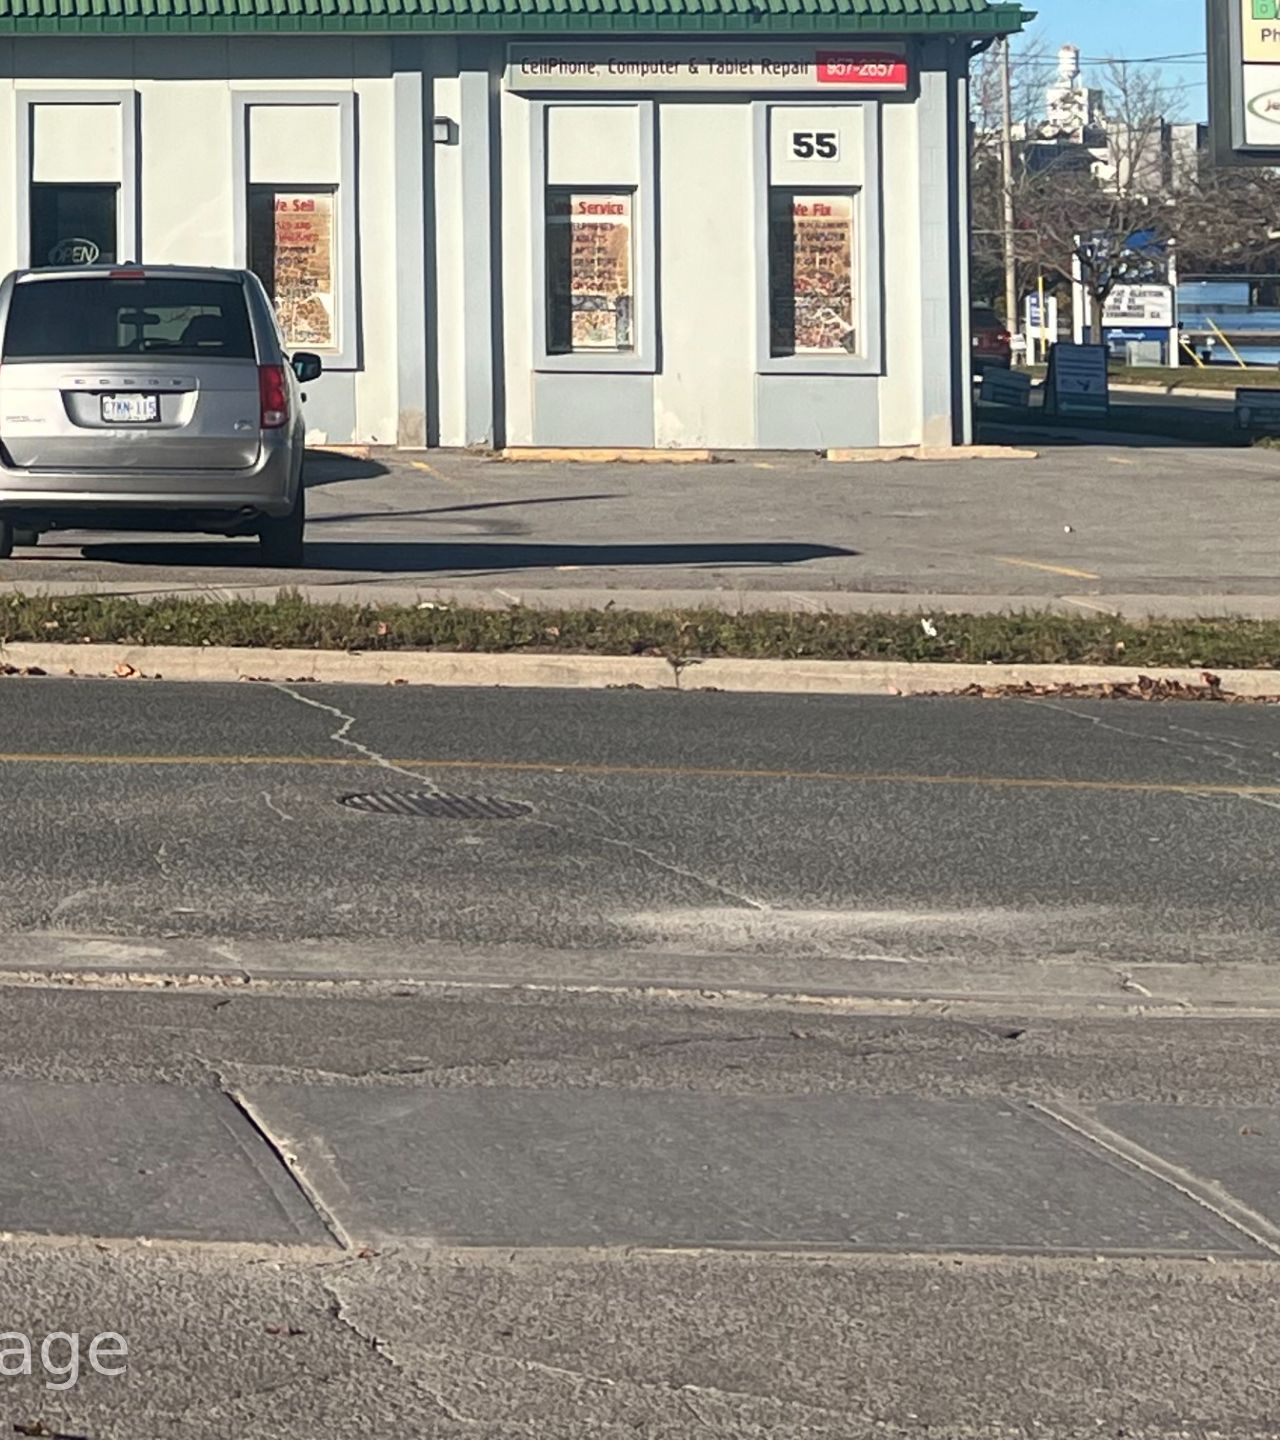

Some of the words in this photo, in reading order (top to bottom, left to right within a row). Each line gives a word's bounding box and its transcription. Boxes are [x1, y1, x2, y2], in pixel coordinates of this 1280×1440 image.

[521, 56, 600, 76] CellPhone,
[608, 57, 681, 76] Computer
[688, 58, 699, 74] &
[708, 58, 753, 75] Tablet
[761, 58, 809, 78] Repair
[793, 133, 837, 158] 55
[579, 201, 624, 215] Service
[813, 203, 831, 216] Fix
